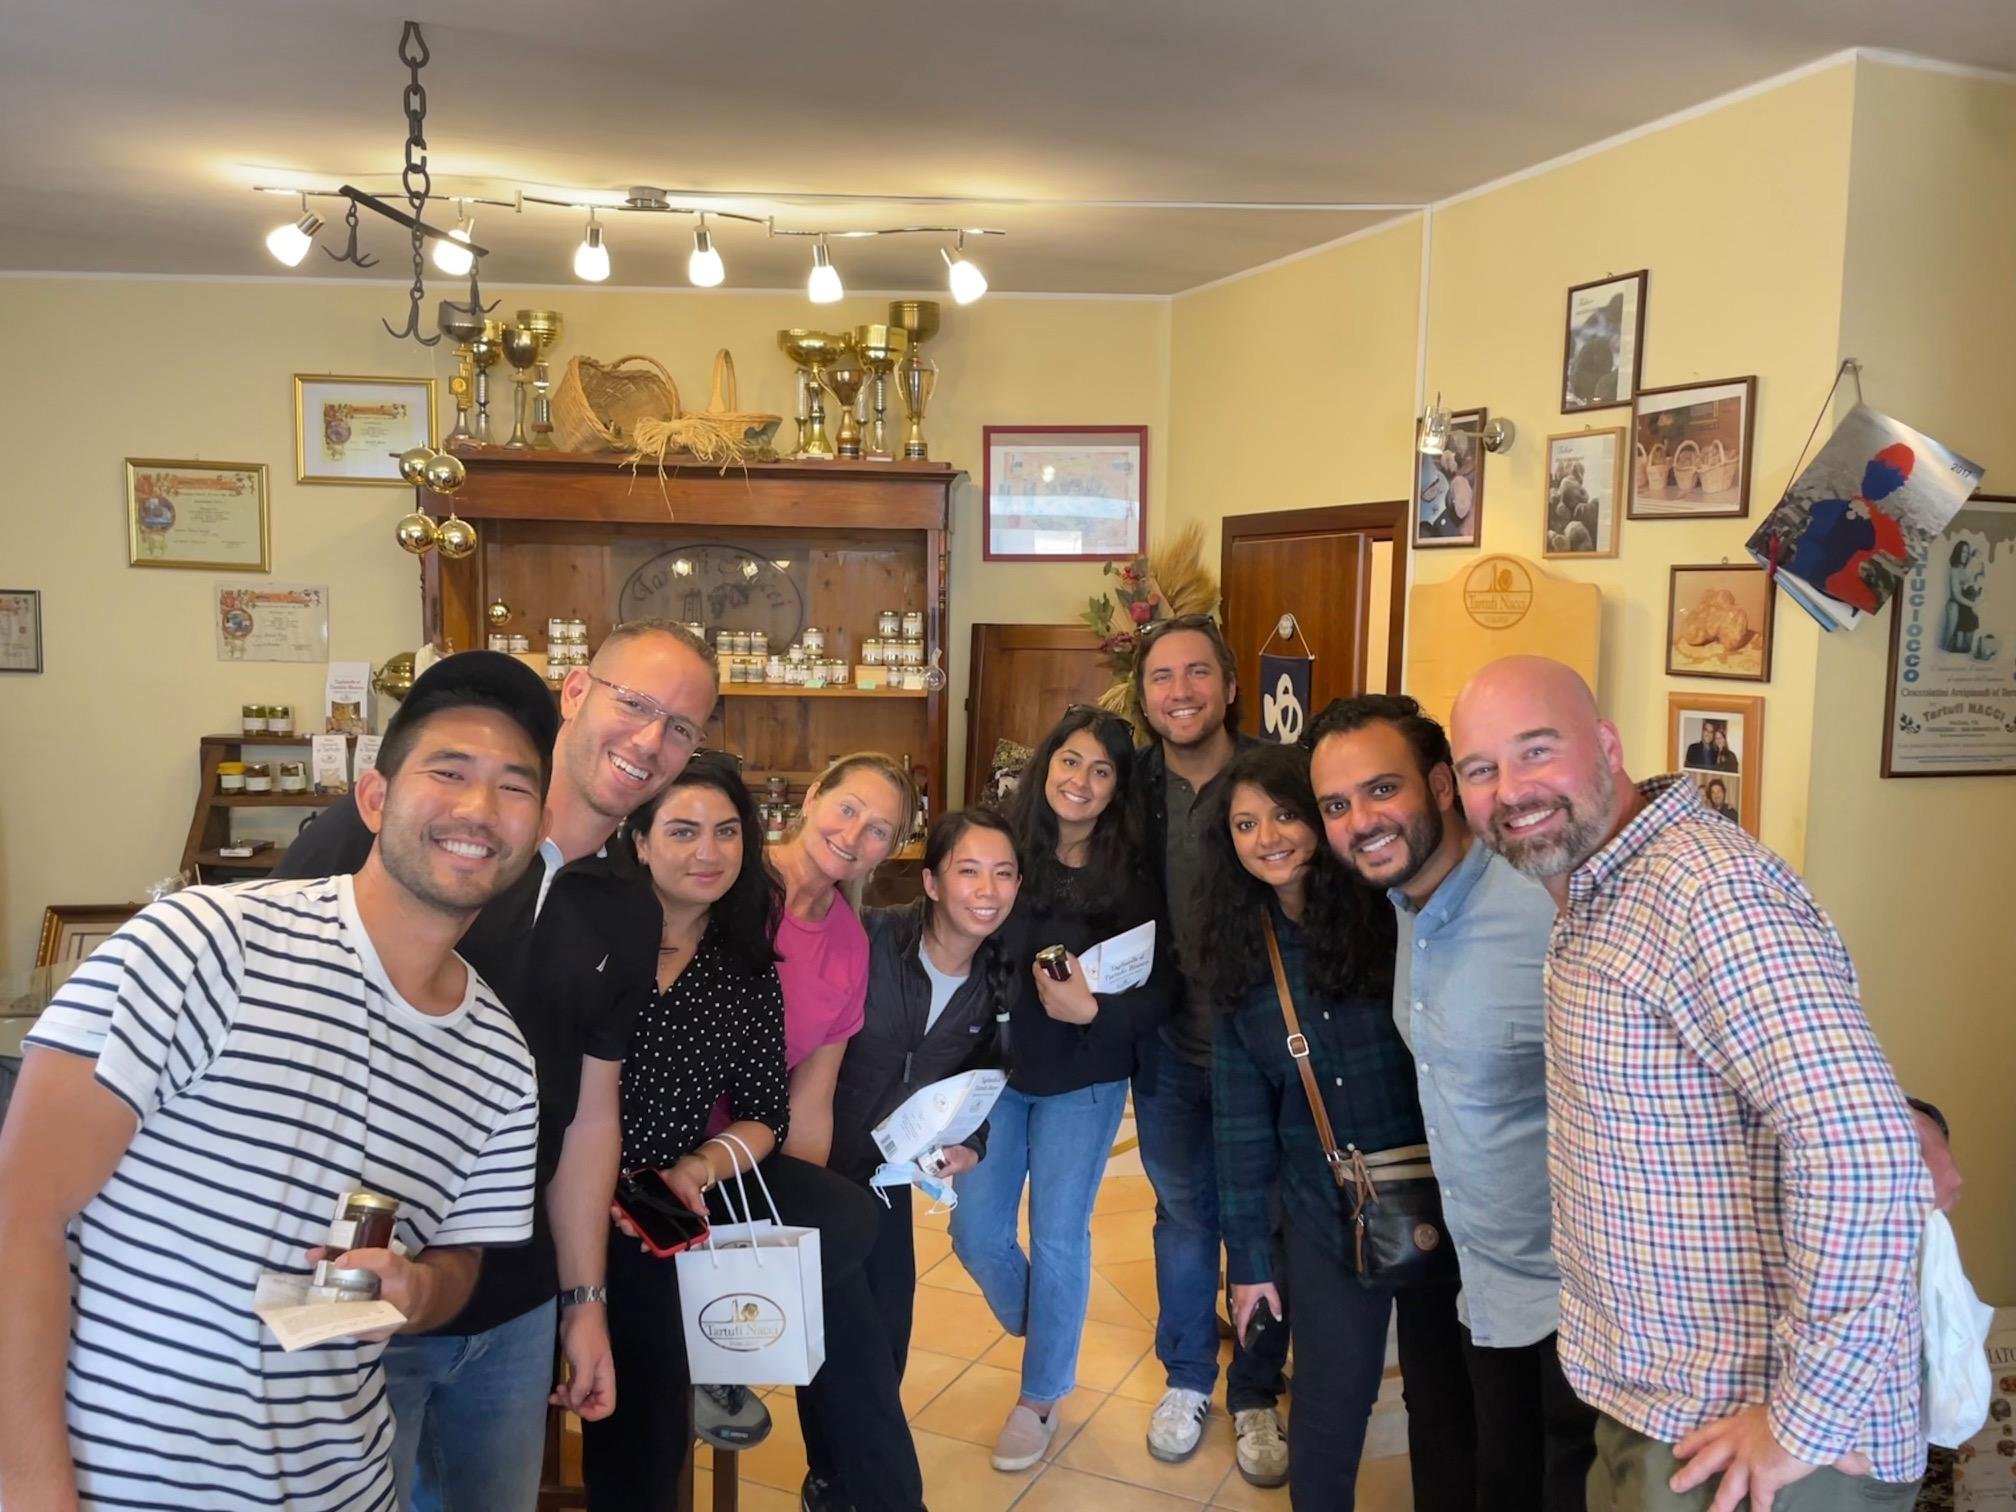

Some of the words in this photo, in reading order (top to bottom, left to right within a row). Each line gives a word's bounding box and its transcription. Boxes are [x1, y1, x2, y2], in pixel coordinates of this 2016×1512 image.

[1950, 463, 1972, 478] 2017
[1922, 703, 1964, 722] Tartufi
[704, 1324, 743, 1337] Tartufi
